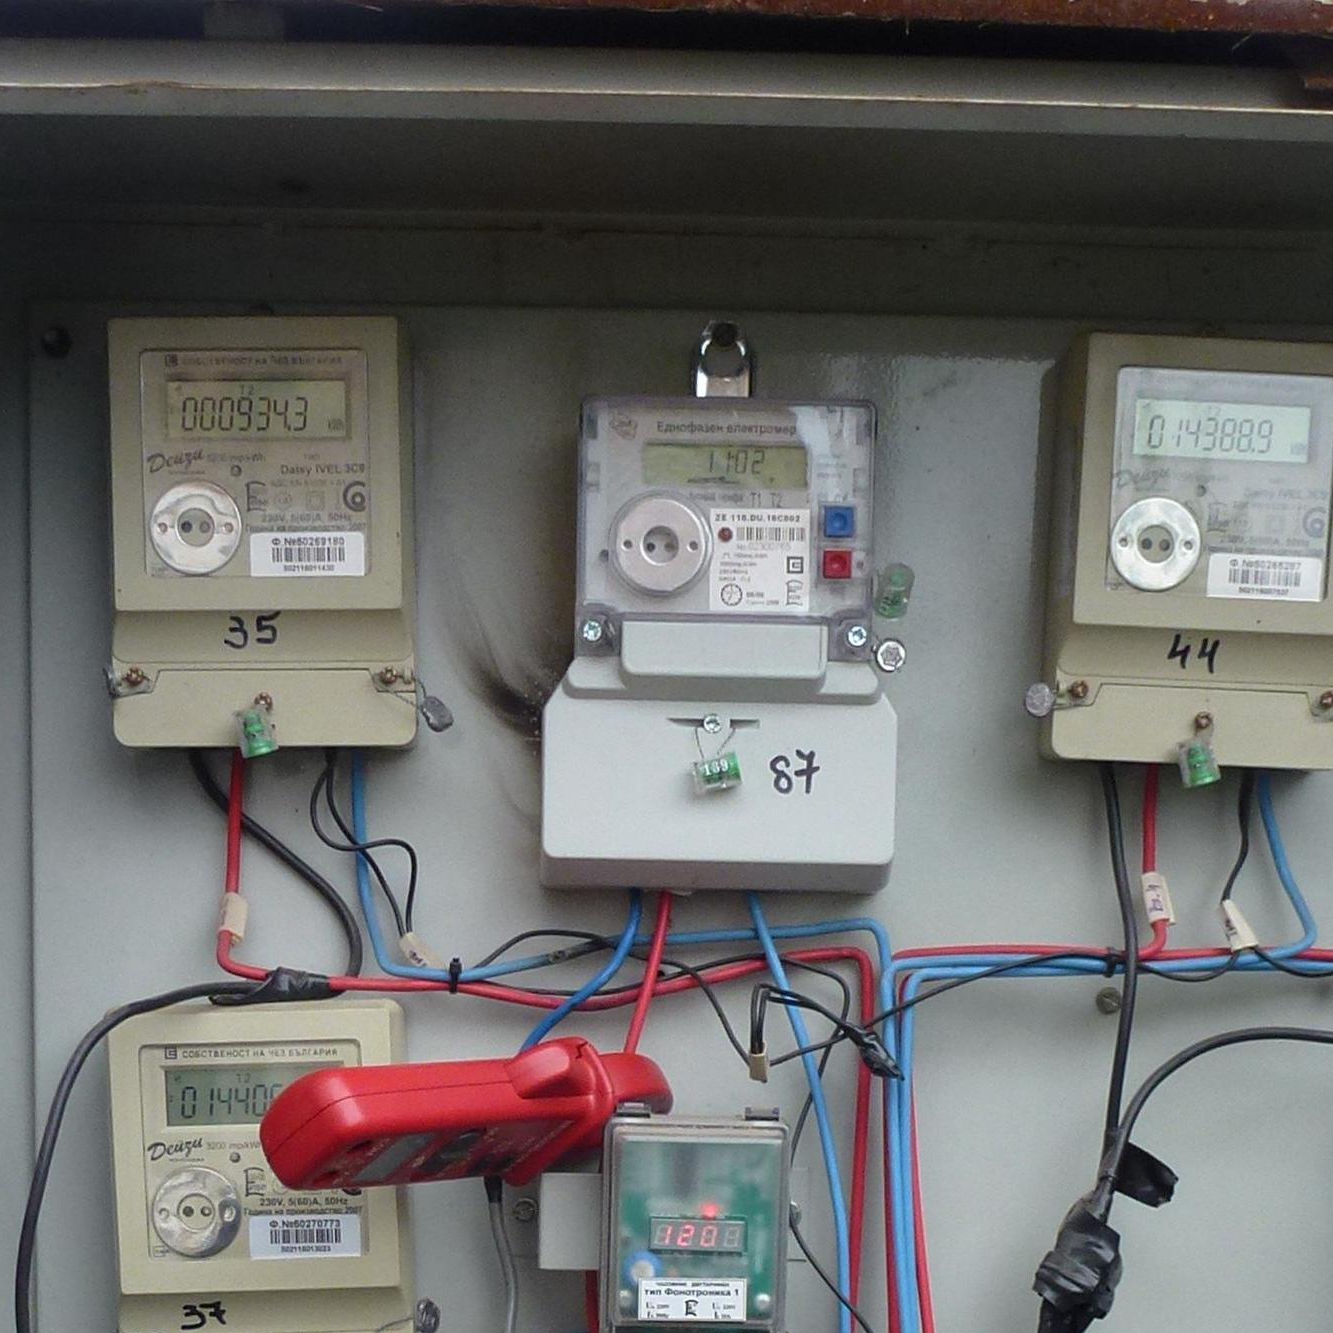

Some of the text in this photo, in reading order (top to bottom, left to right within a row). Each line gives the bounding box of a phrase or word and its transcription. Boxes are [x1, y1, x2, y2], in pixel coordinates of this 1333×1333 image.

[224, 610, 280, 649] 35
[1167, 633, 1221, 675] 44
[769, 748, 820, 795] 87
[181, 1301, 227, 1331] 37
